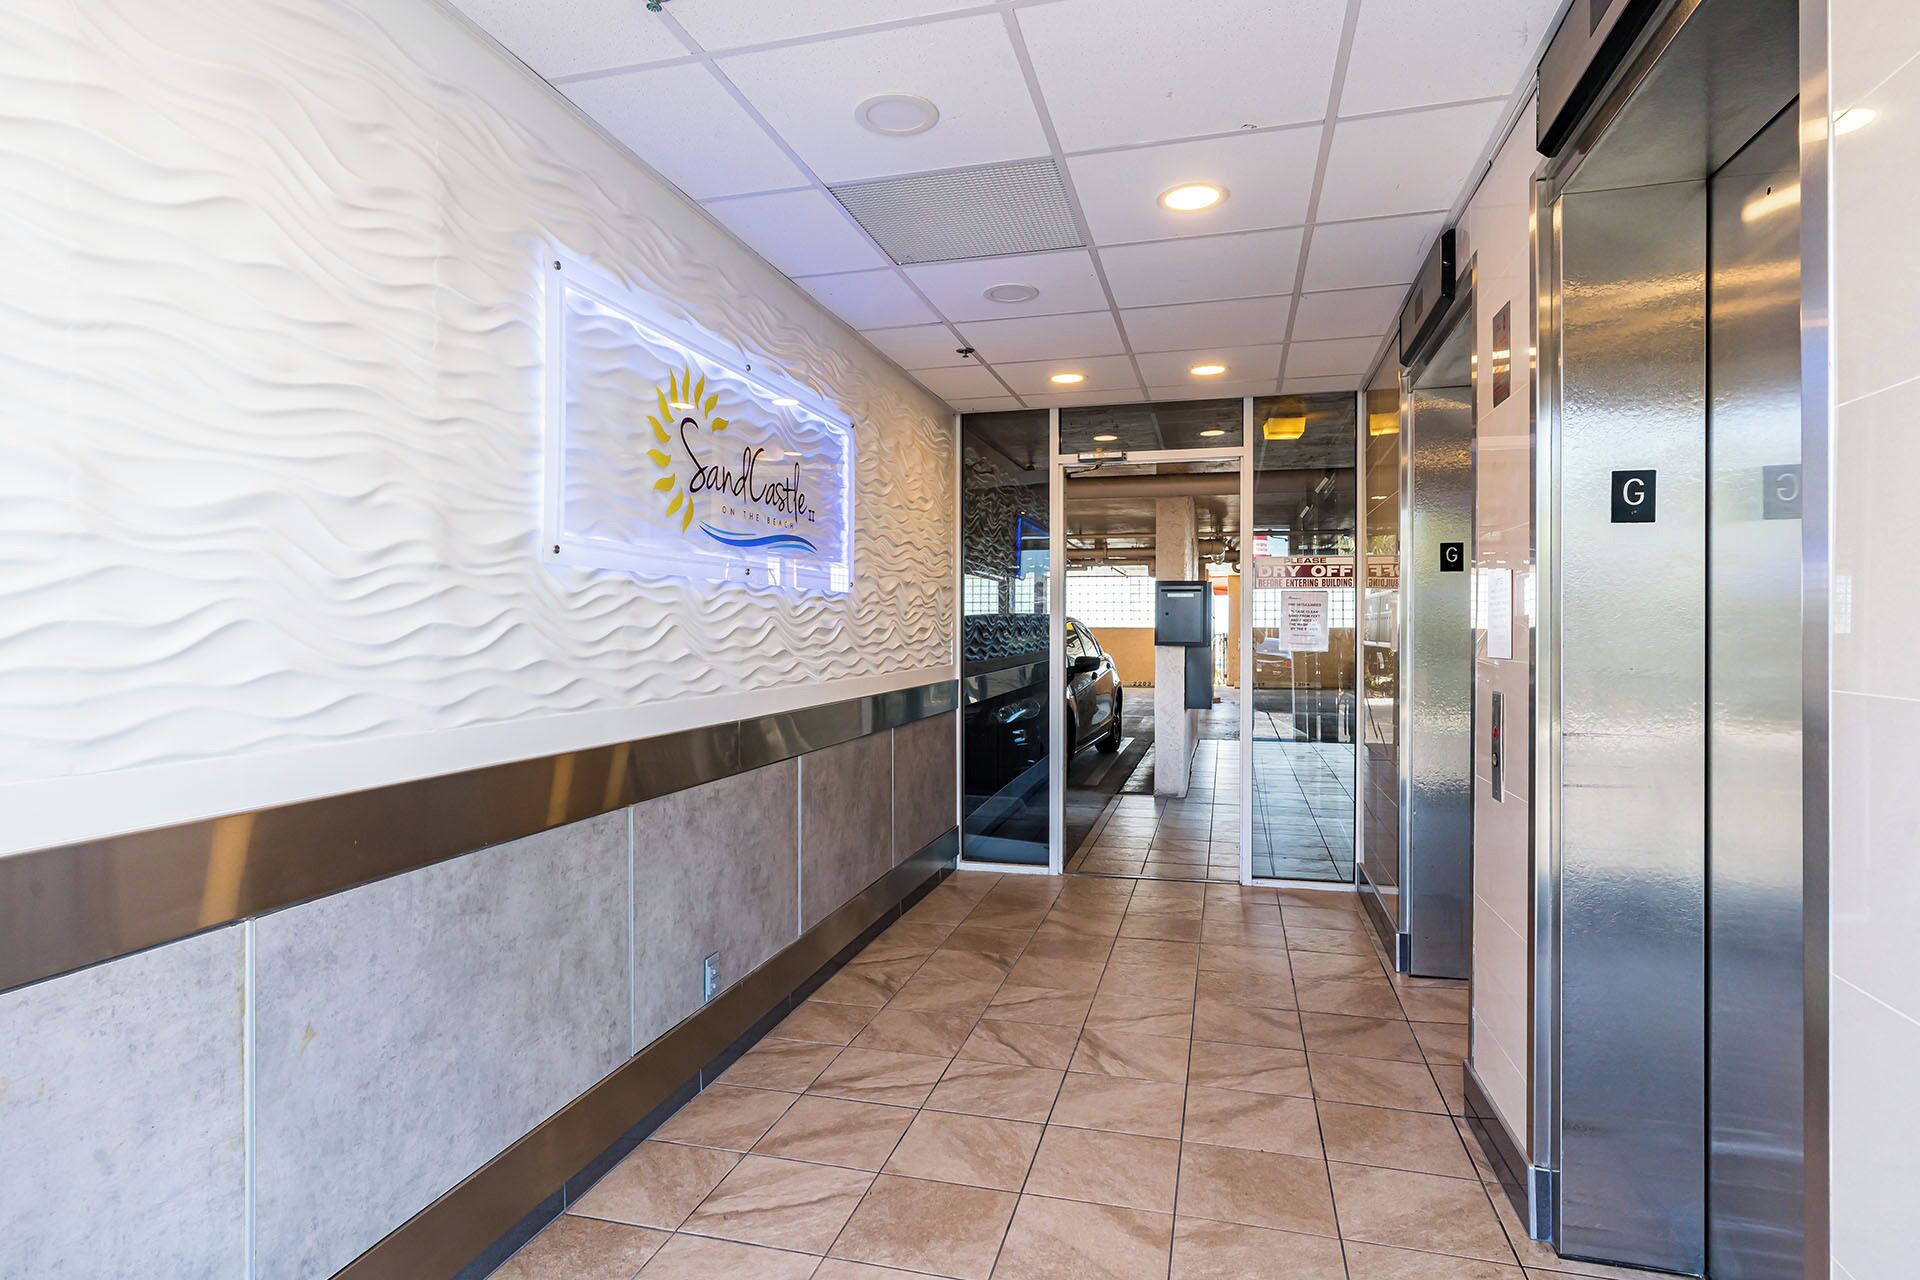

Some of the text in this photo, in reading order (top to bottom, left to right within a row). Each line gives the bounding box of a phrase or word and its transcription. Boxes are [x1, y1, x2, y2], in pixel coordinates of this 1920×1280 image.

[1622, 477, 1645, 506] G
[721, 505, 794, 529] ON THE BEACH
[1446, 546, 1458, 563] G
[1258, 565, 1353, 577] DRY OFF
[1258, 578, 1353, 587] BEFORE ENTERING BUILDING
